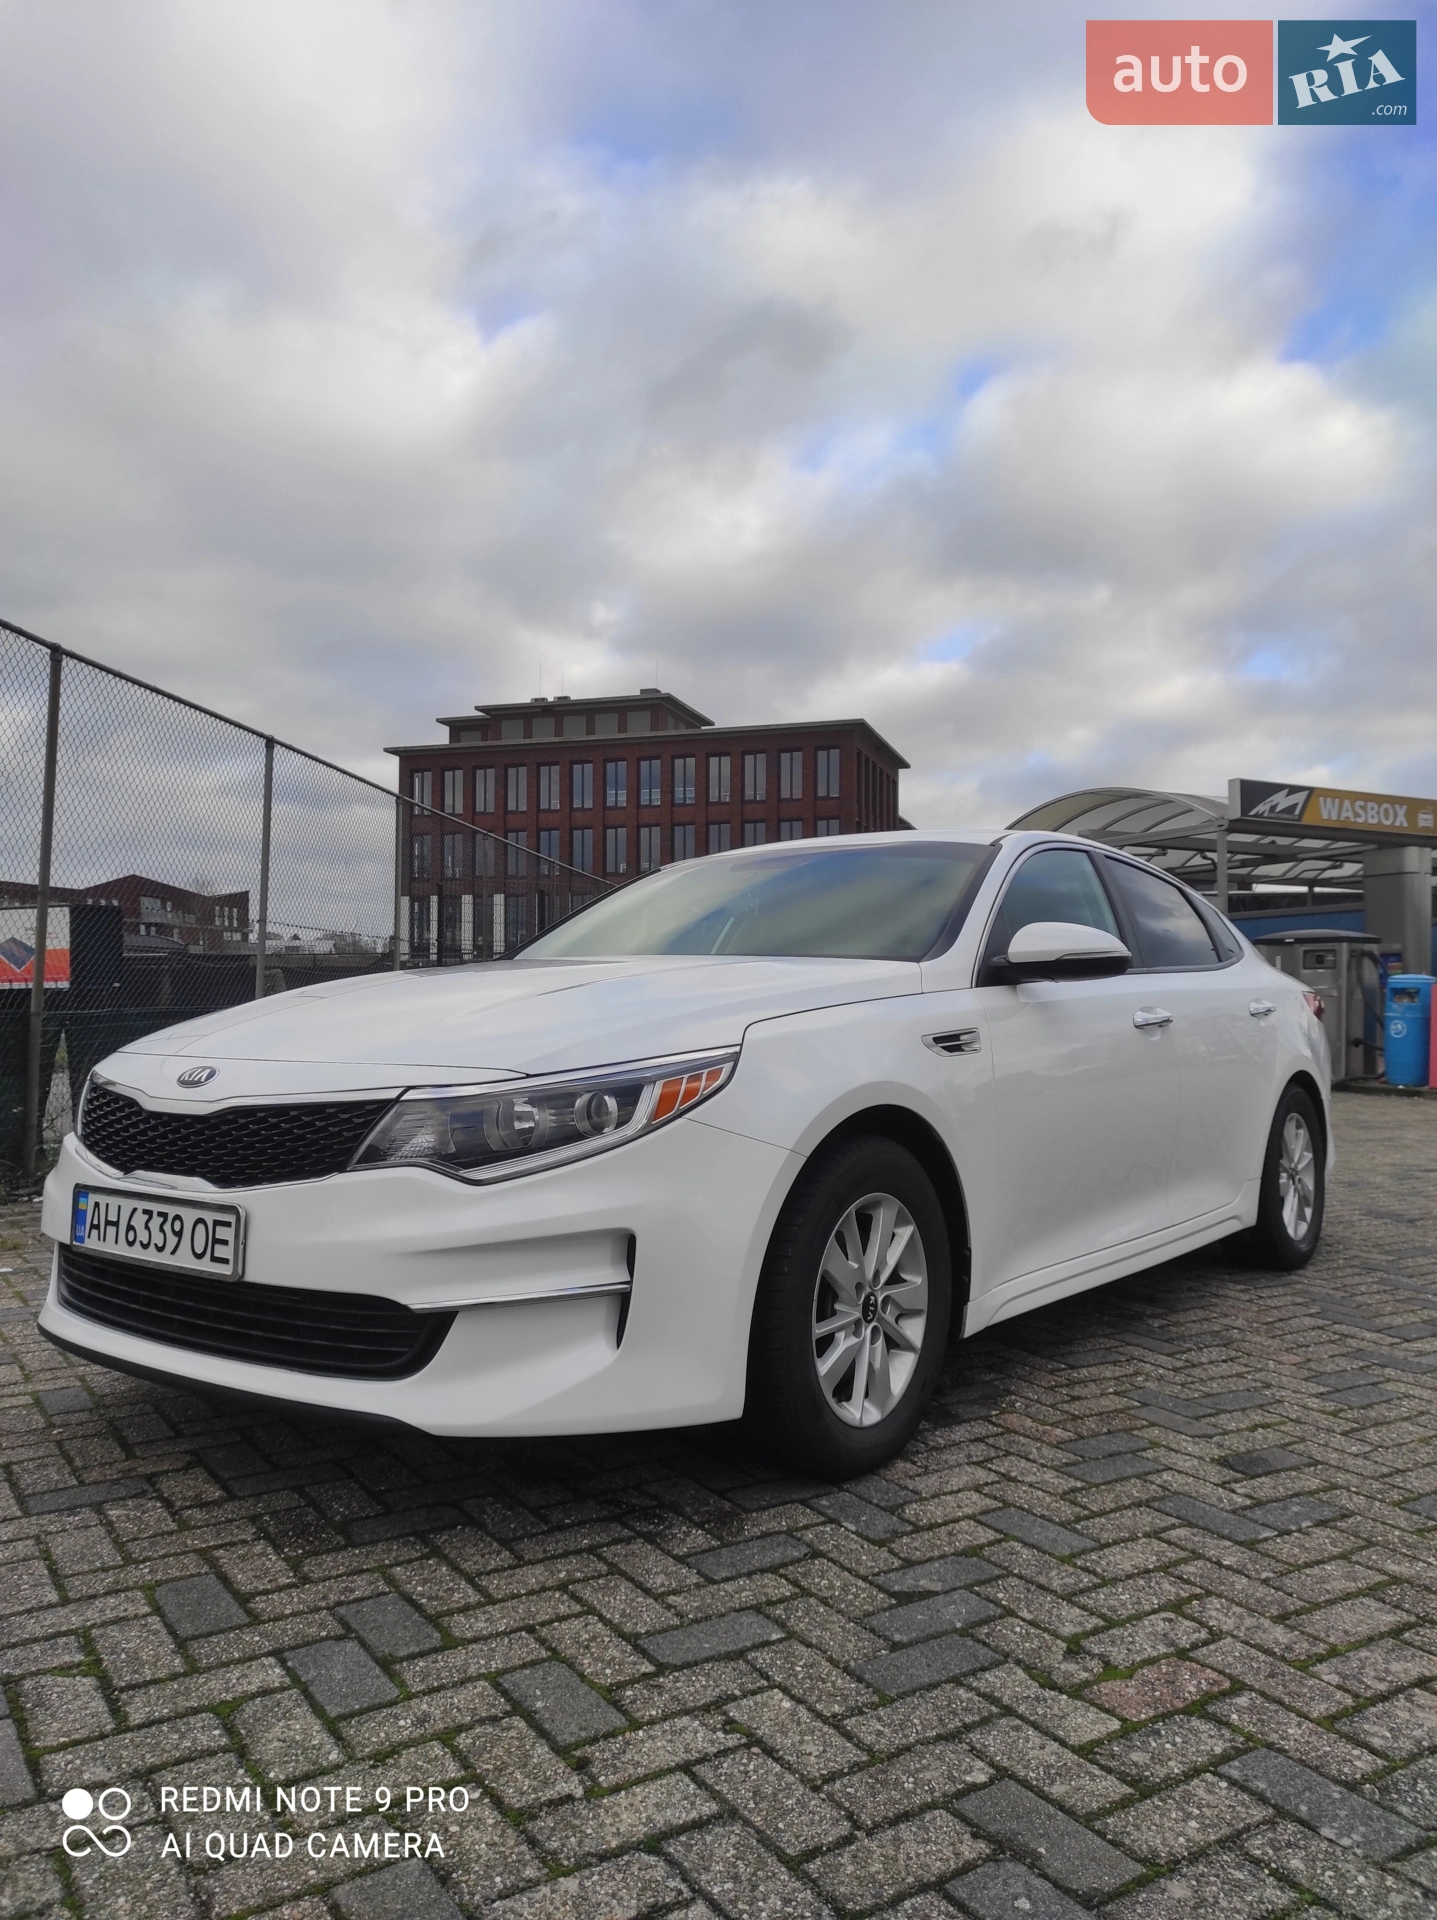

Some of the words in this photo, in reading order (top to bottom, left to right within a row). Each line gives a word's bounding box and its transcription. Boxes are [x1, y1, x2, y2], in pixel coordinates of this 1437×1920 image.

[1319, 796, 1409, 828] WASBOX
[180, 1068, 211, 1082] KIA
[76, 1224, 85, 1237] UA
[87, 1201, 122, 1245] AH
[125, 1207, 184, 1256] 6339
[191, 1217, 232, 1265] OE
[867, 1295, 875, 1320] KIA
